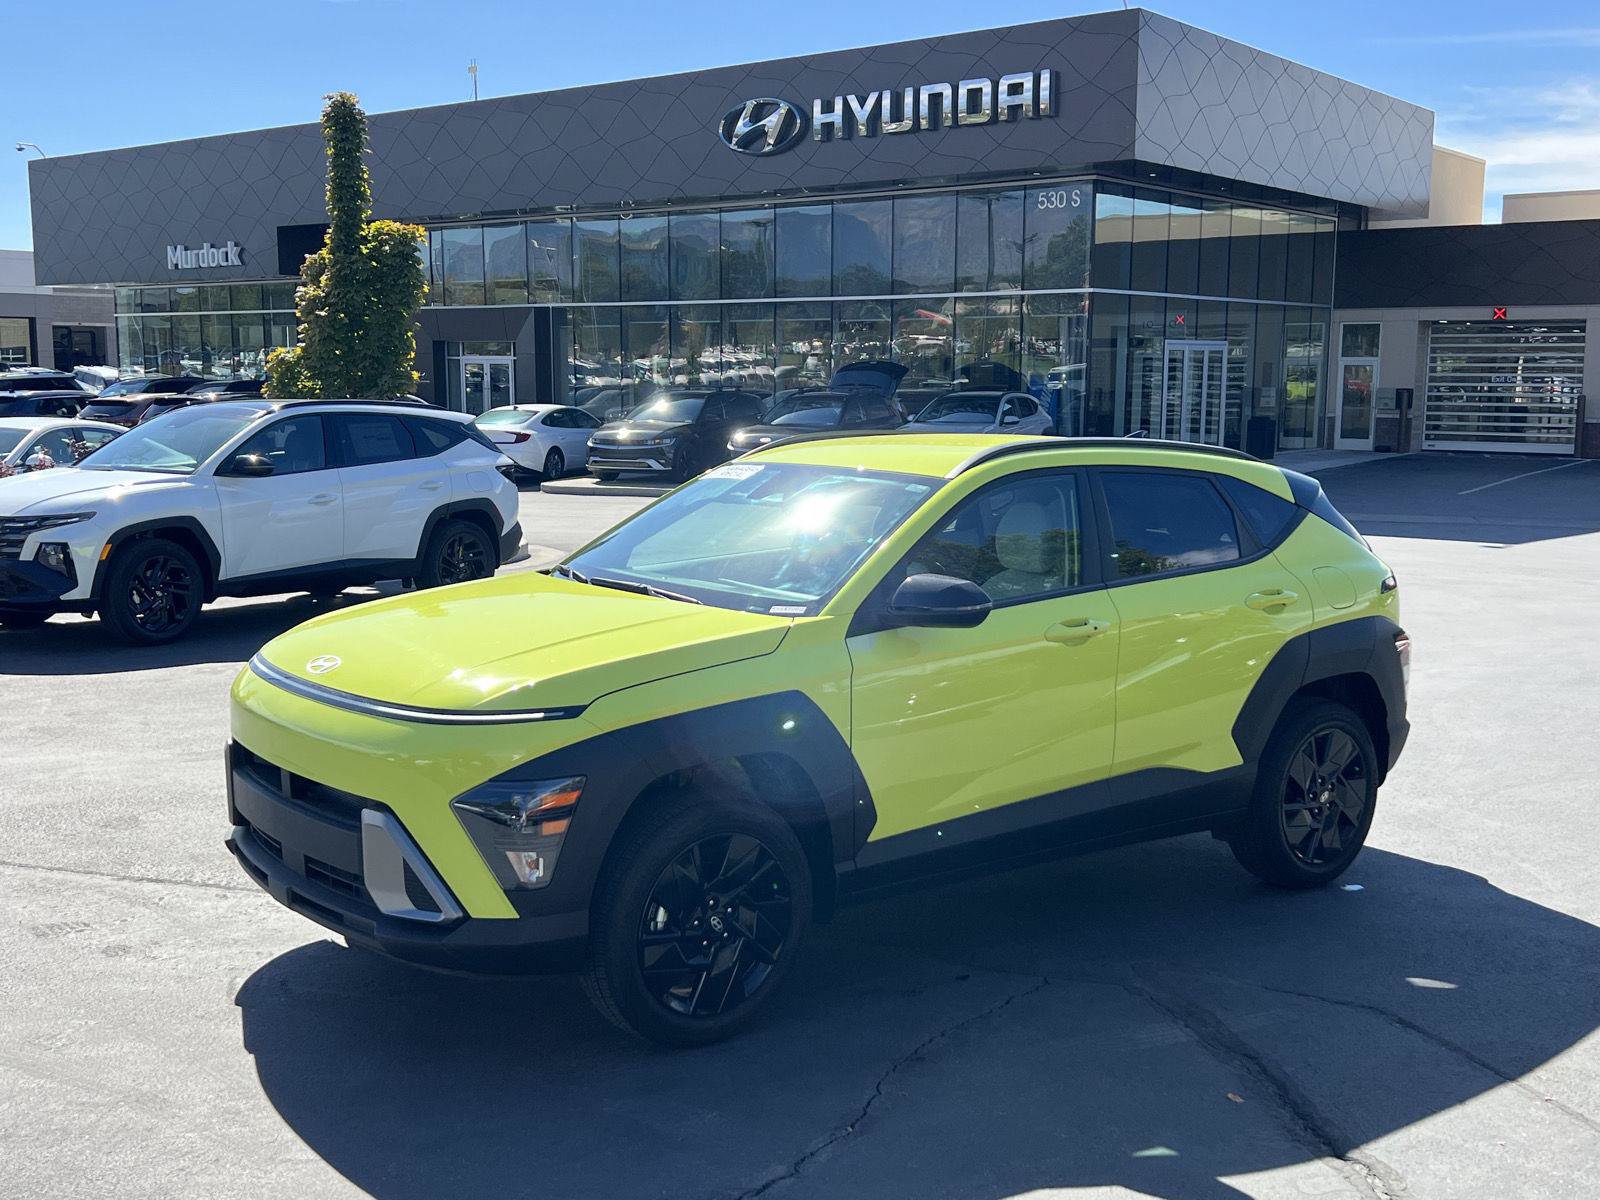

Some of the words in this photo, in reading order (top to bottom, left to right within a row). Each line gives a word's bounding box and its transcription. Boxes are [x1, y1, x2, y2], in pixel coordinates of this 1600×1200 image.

[812, 69, 1056, 142] HYUNDAI
[1038, 191, 1067, 209] 530
[1071, 189, 1081, 207] S
[167, 241, 243, 270] Murdock
